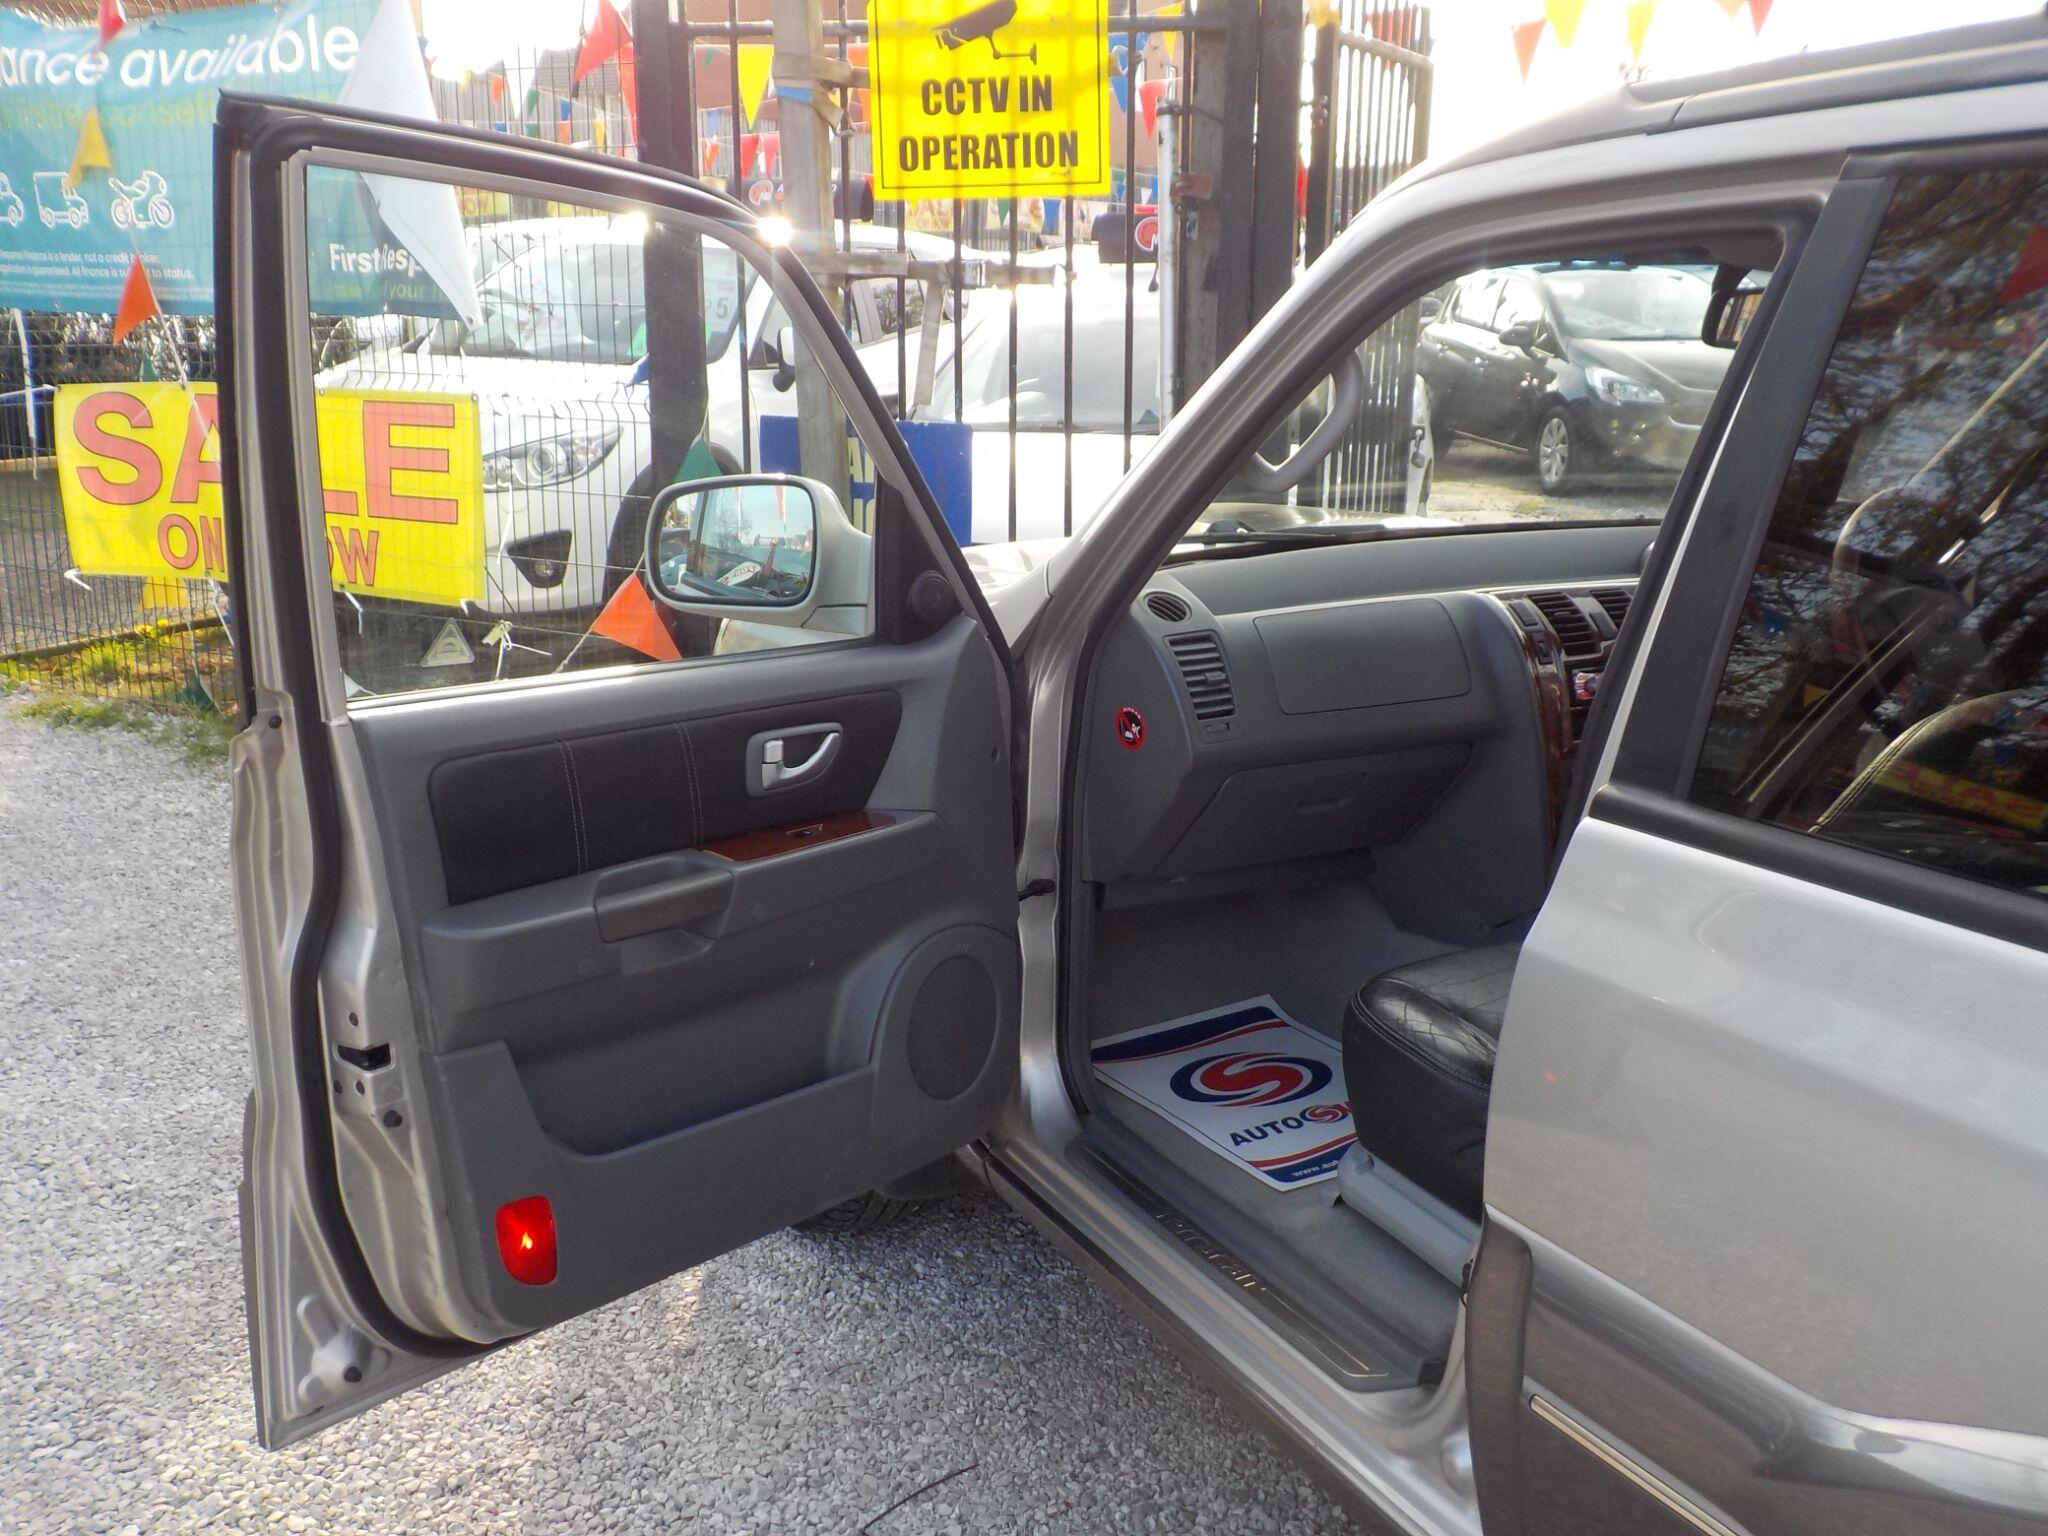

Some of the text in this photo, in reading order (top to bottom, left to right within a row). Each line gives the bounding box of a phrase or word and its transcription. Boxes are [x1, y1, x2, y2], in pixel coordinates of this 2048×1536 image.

[120, 15, 359, 88] available
[921, 74, 1053, 116] CCTV IN
[898, 130, 1079, 172] OPERATION
[73, 391, 459, 525] SAE
